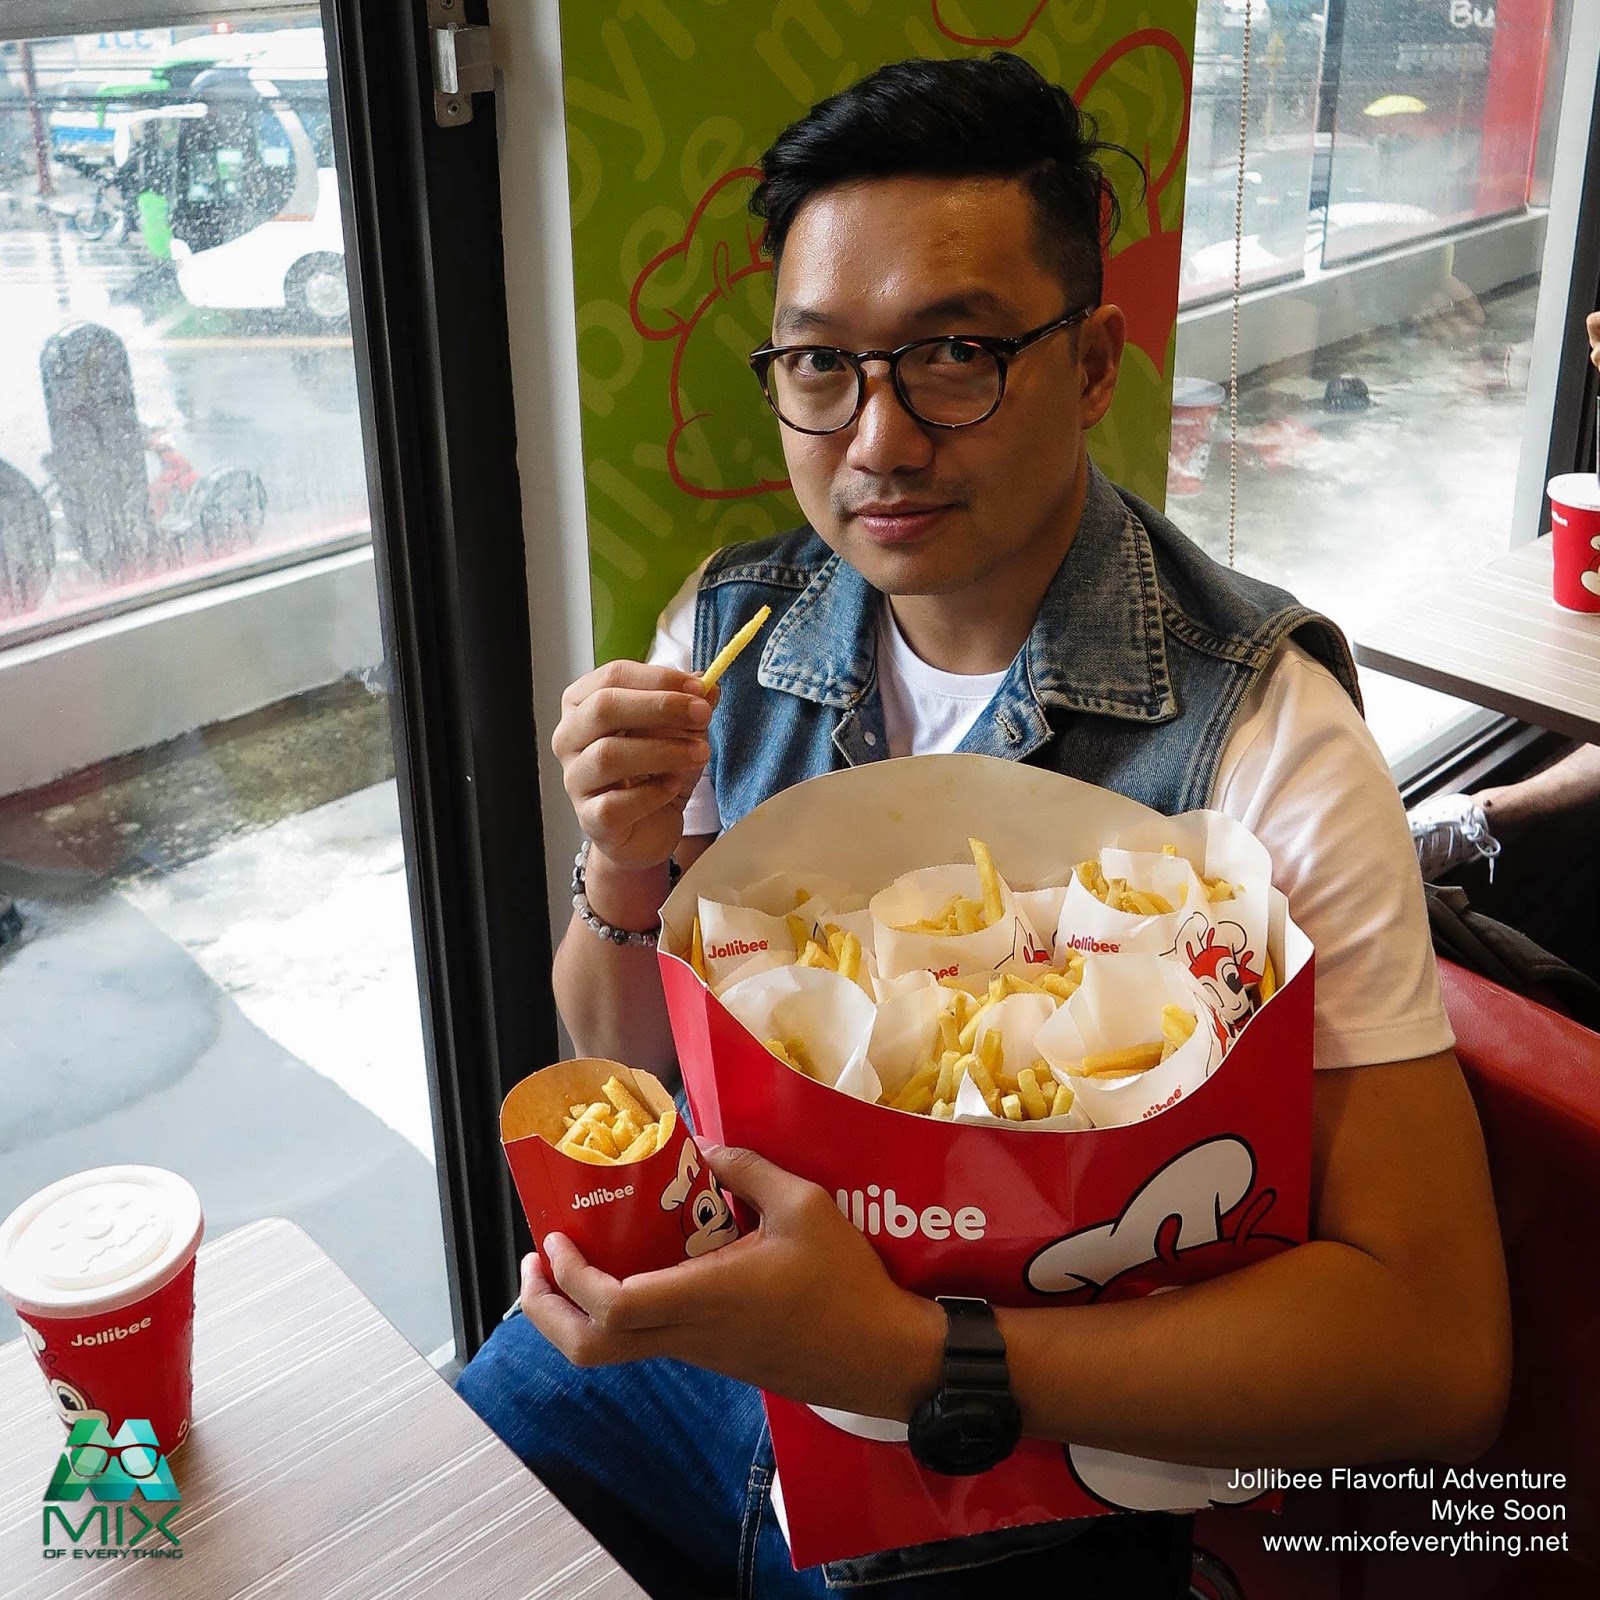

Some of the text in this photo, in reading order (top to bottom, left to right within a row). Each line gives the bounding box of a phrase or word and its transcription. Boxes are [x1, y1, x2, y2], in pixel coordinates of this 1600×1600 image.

[707, 939, 769, 959] Jollibee
[1066, 933, 1121, 953] Jollibee
[570, 1184, 635, 1211] Jollibee
[835, 1183, 987, 1241] llibee
[70, 1316, 152, 1347] Jollibee
